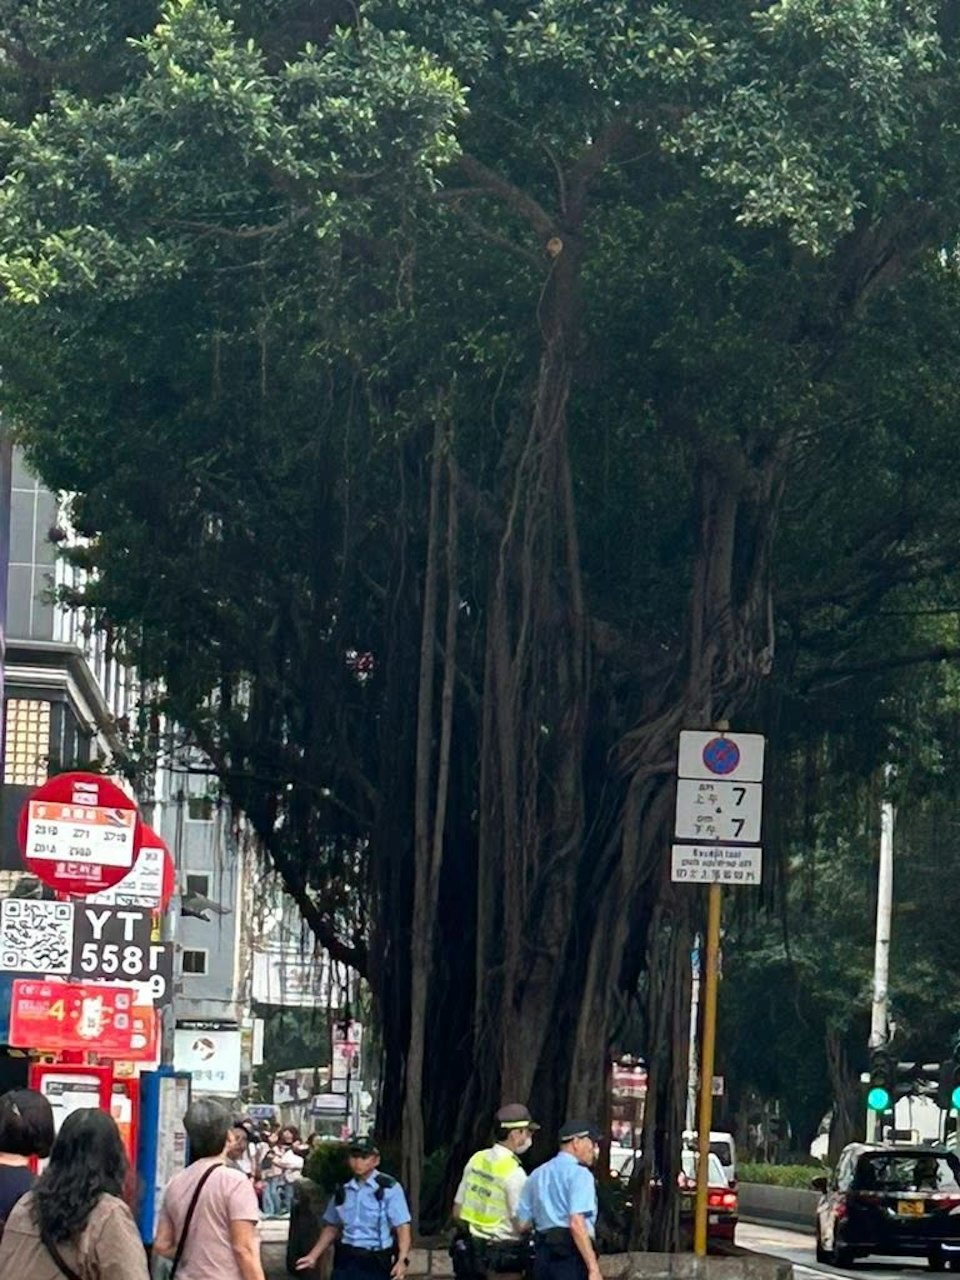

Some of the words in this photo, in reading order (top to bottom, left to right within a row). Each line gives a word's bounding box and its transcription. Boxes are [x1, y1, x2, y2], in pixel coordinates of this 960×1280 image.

[732, 787, 746, 806] 7
[731, 819, 745, 837] 7
[85, 909, 143, 941] YT
[80, 943, 143, 975] 558
